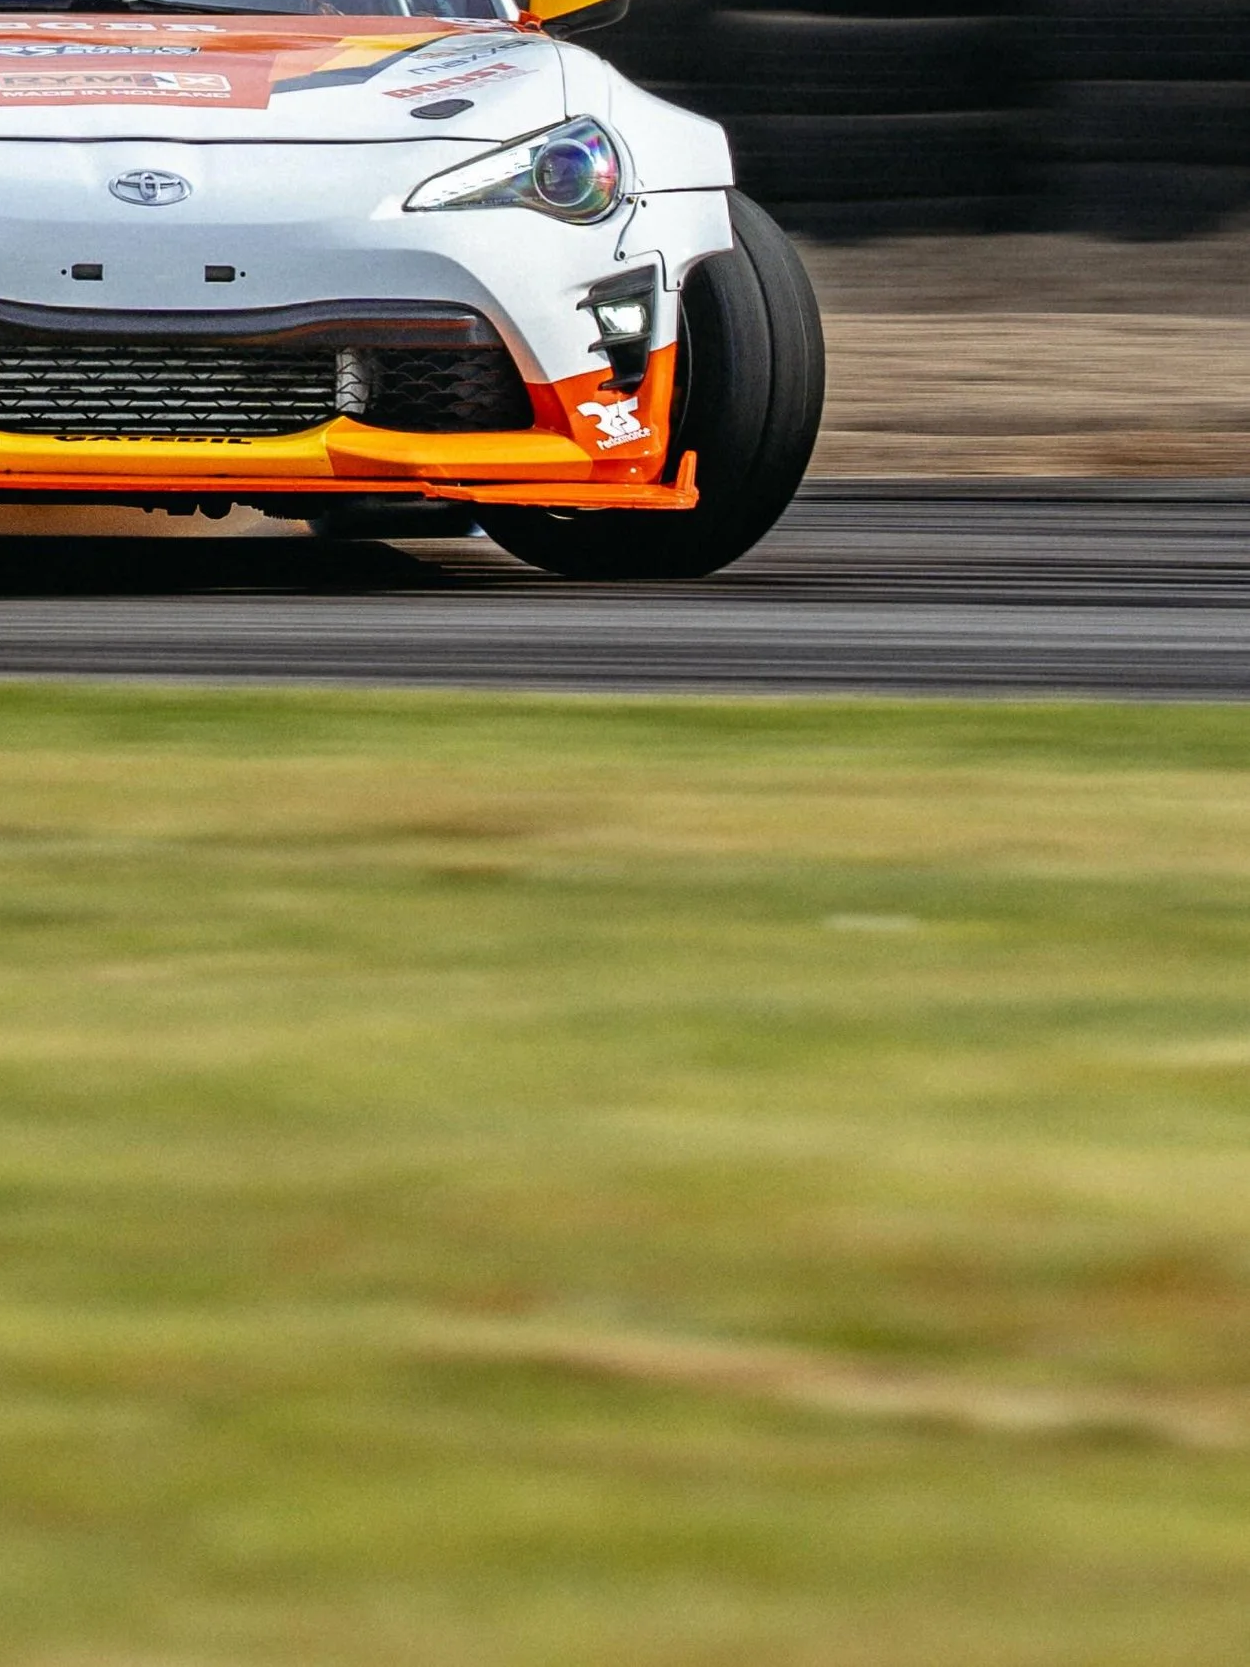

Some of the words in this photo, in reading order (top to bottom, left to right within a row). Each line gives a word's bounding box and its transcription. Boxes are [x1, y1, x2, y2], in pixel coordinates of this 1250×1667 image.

[2, 74, 221, 88] RYMAX
[382, 62, 519, 99] BOOST
[2, 90, 75, 98] MADE
[111, 89, 231, 99] HOLLAND
